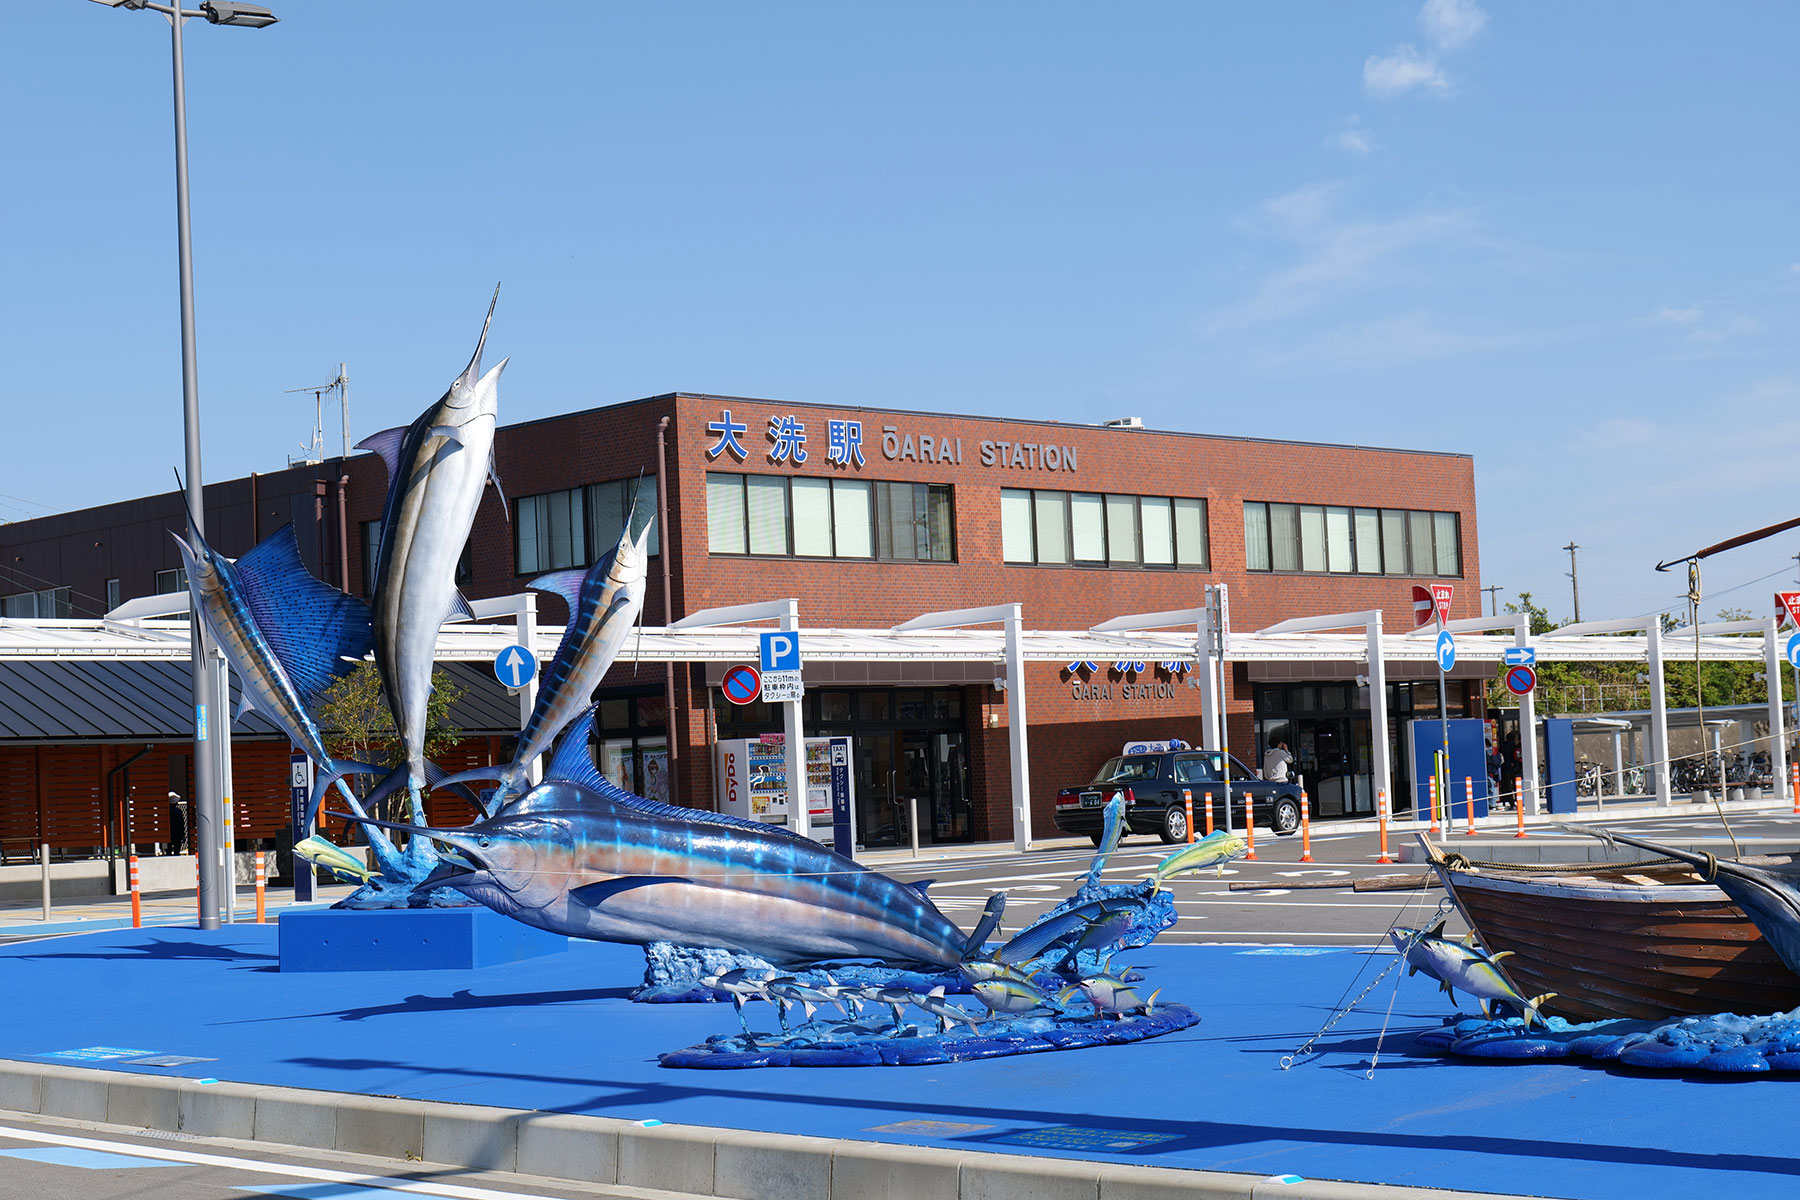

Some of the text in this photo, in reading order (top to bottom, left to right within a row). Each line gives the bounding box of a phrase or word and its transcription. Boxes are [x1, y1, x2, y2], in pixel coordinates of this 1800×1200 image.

[707, 410, 866, 467] 大洗駅
[980, 439, 1079, 472] STATION
[1436, 590, 1450, 600] 止まれ
[1438, 602, 1448, 610] STOP
[769, 635, 793, 668] P
[763, 674, 800, 683] ここから11mの
[763, 683, 800, 691] 駐車枠内は
[1122, 683, 1176, 700] STATION
